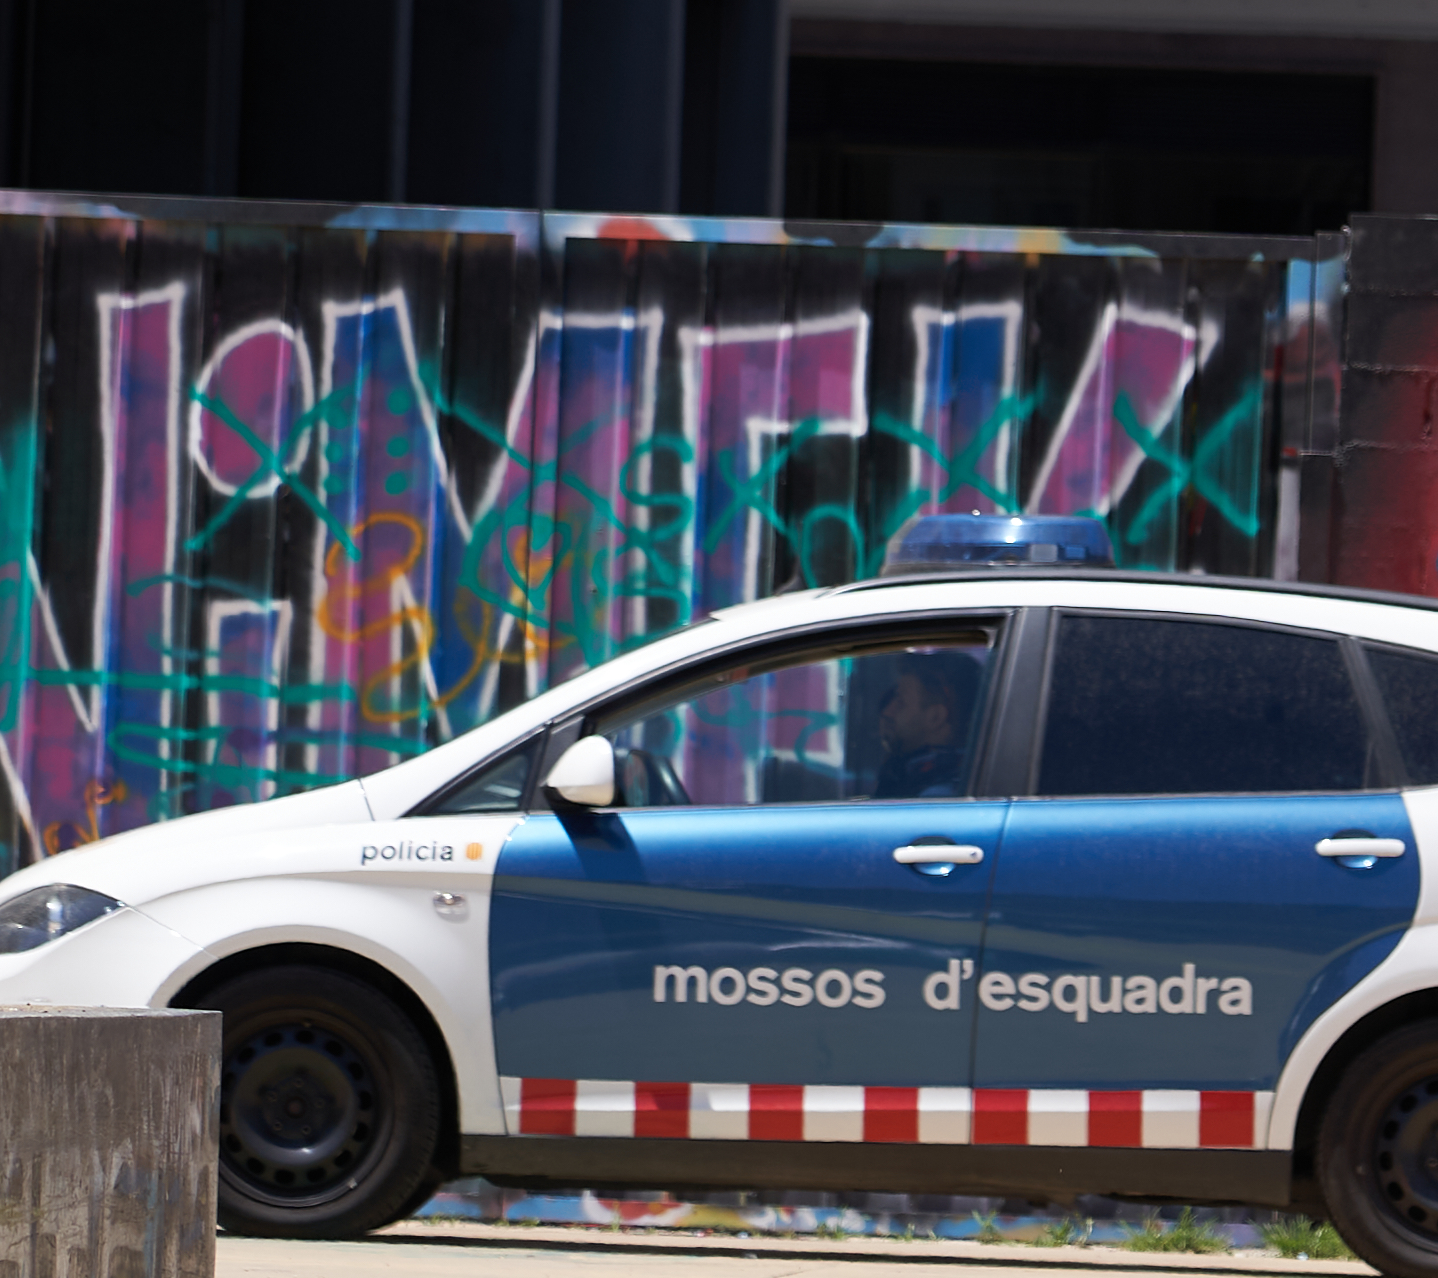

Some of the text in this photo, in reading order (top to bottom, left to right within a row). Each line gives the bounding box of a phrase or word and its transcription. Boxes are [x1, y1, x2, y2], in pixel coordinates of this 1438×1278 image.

[361, 840, 454, 866] policia
[653, 958, 1254, 1023] mossos d'esquadra
